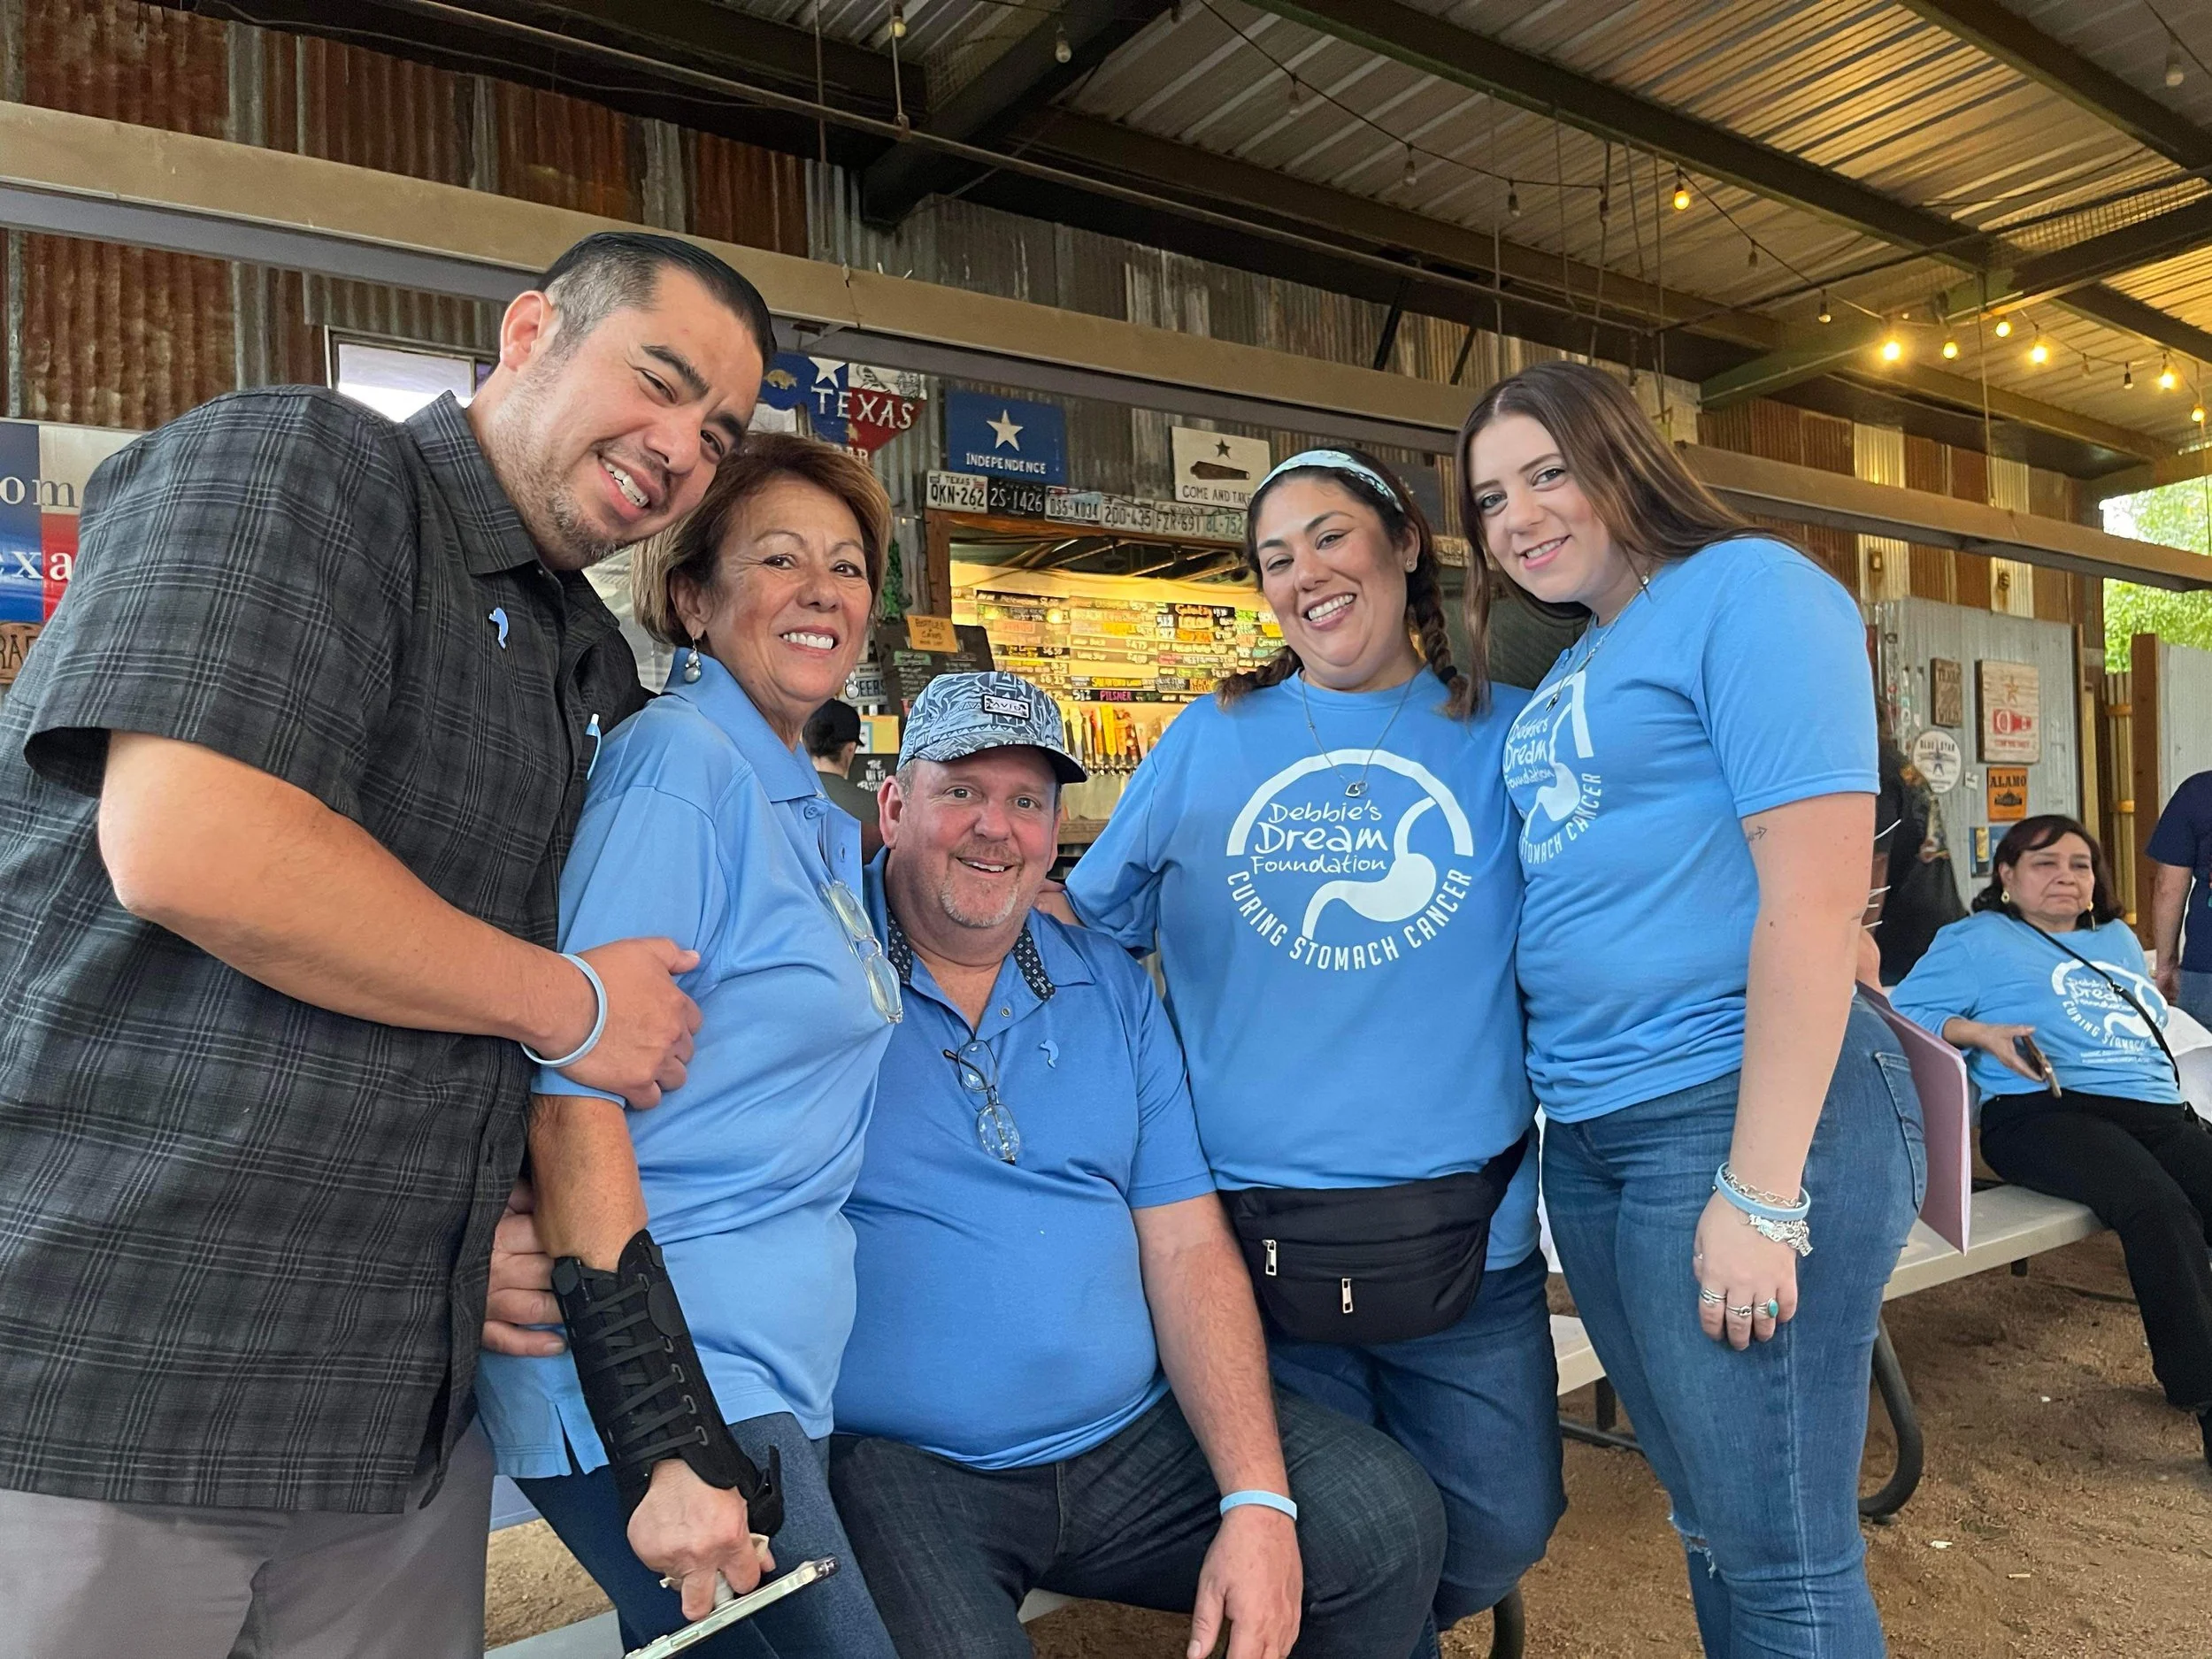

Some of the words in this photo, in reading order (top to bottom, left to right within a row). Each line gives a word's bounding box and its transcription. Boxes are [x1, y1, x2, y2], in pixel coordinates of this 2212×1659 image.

[810, 386, 915, 430] TEXAS
[965, 453, 1047, 474] INDEPENDENCE
[945, 475, 971, 486] TEXAS
[1182, 485, 1209, 500] COME
[1212, 488, 1231, 502] AND
[0, 551, 73, 581] xa
[856, 680, 887, 696] EERS
[1100, 690, 1132, 701] PILSNER
[1505, 740, 1548, 772] Dream
[1990, 774, 2026, 787] ALAMO
[1268, 800, 1382, 823] Debbie's
[1565, 772, 1602, 841] CANCER
[1255, 822, 1388, 854] Dream
[1250, 854, 1386, 874] Foundation
[1227, 871, 1288, 947] CURING
[1289, 935, 1400, 971] STOMACH
[1402, 868, 1472, 949] CANCER
[2062, 1001, 2101, 1038] CURING
